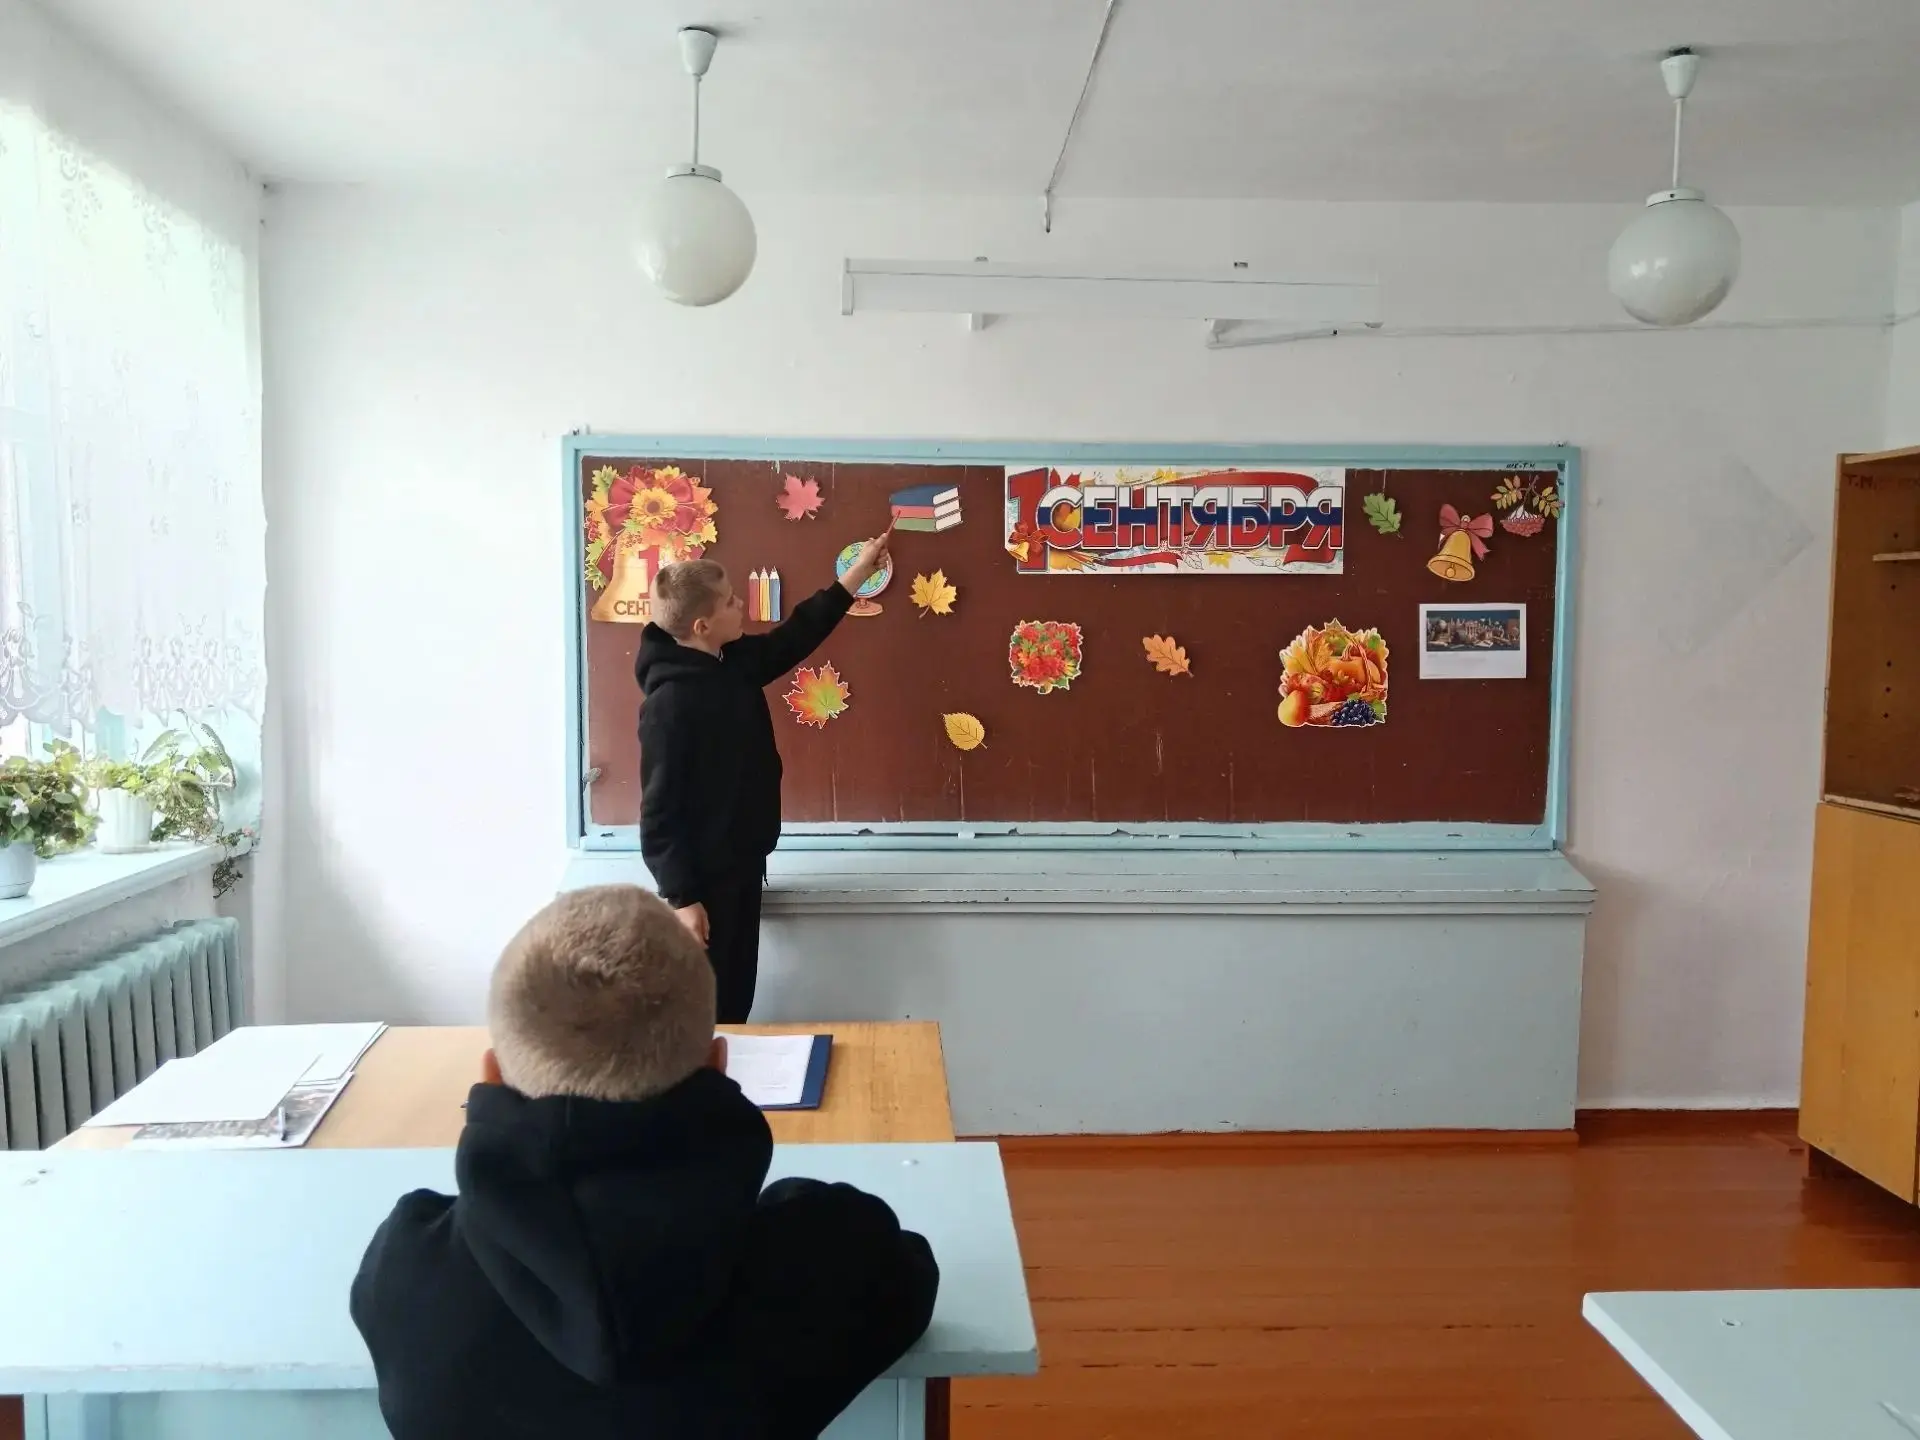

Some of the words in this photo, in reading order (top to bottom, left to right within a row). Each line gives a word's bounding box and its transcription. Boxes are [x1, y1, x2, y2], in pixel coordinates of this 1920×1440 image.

[1008, 467, 1049, 572] 1
[1036, 485, 1343, 550] СЕНТЯБРЯ
[638, 545, 660, 599] 1
[613, 600, 652, 616] СЕНТ
